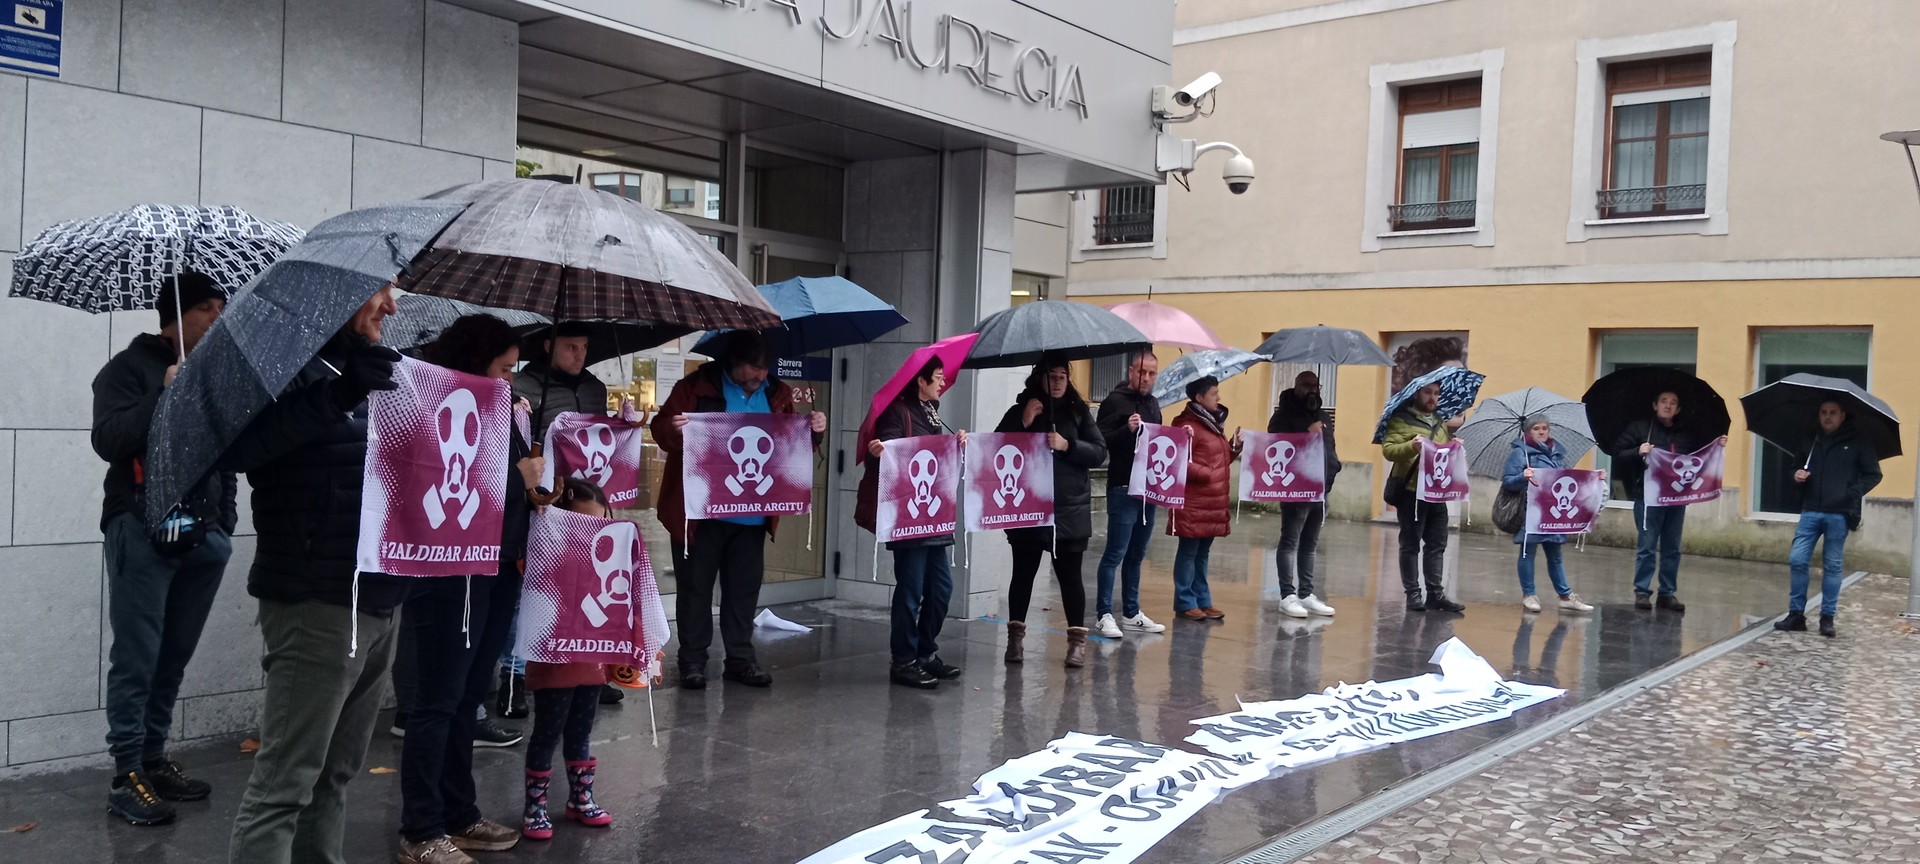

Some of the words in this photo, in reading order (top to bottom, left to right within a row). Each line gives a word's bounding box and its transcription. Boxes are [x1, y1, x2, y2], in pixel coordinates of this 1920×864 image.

[819, 0, 1089, 119] JAUREGIA
[778, 357, 803, 368] Sarrera
[778, 367, 803, 378] Entrada
[608, 487, 639, 504] ARGIT
[1288, 490, 1316, 498] ARGITU
[706, 502, 763, 514] #ZALDIBAR
[763, 502, 804, 512] ARGITU
[1018, 512, 1045, 522] ARGITU
[935, 521, 957, 533] ARGI
[381, 541, 462, 562] #ZALDIBAR
[462, 545, 501, 562] ARGIT
[547, 638, 633, 654] #ZALDIBAR
